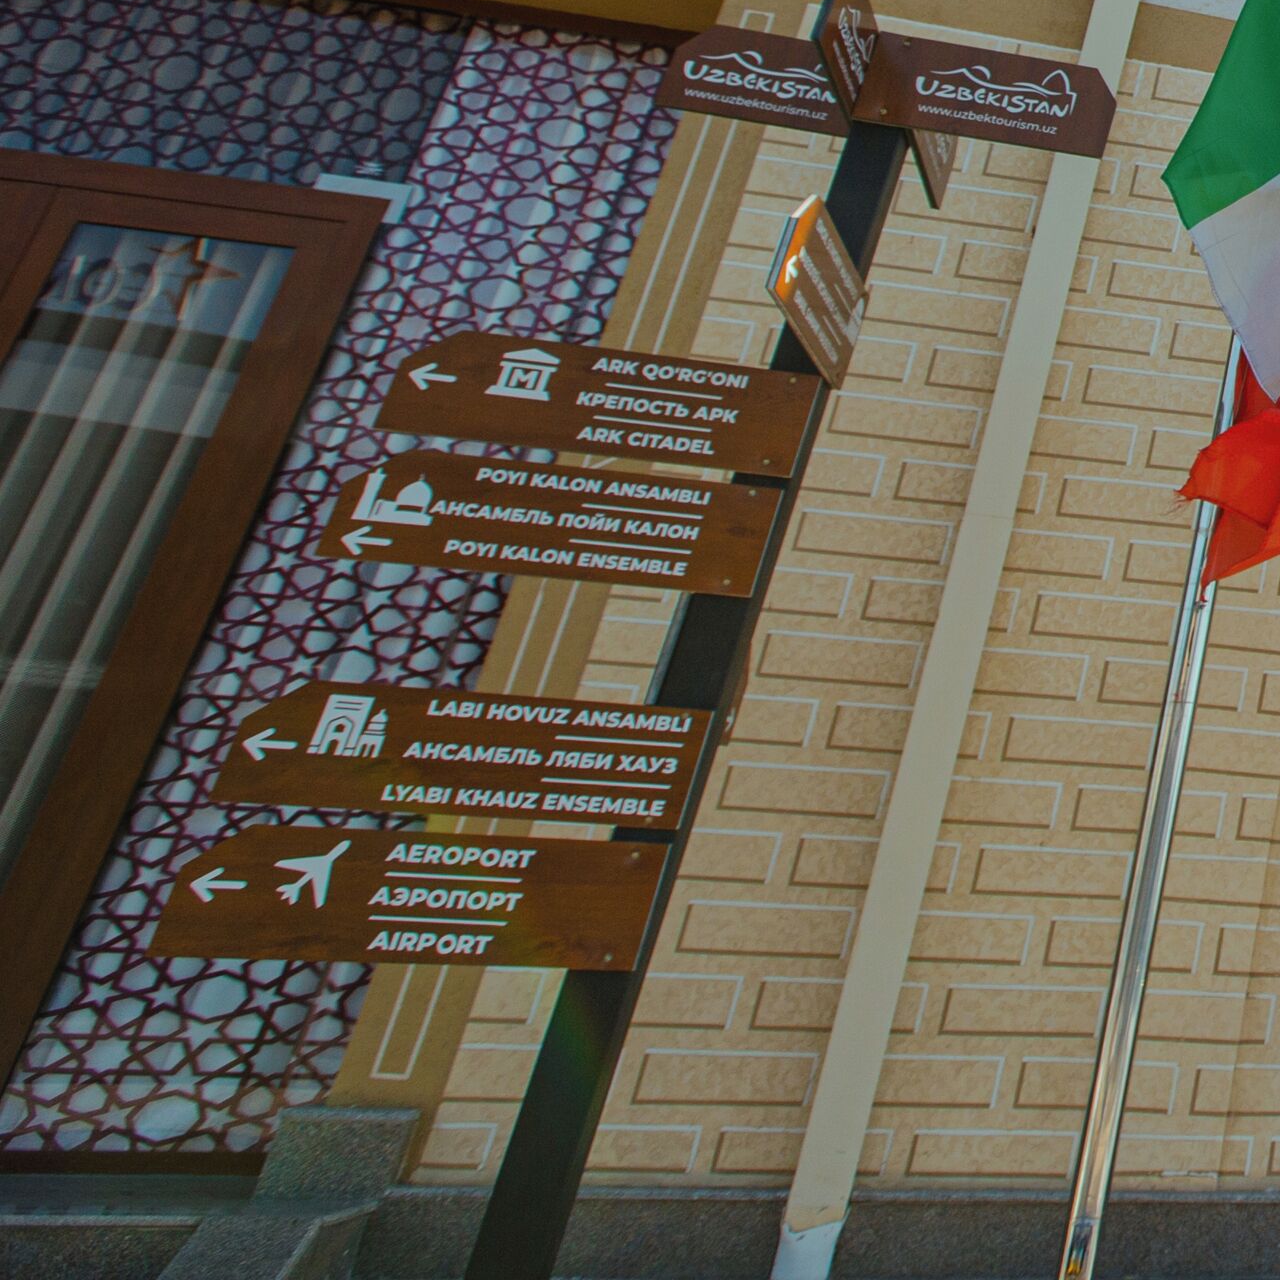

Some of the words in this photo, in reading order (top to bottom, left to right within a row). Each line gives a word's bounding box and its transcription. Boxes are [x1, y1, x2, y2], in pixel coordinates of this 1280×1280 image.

[684, 87, 829, 120] www.uzbektourism.uz
[915, 76, 1069, 118] UZBEKISTAN
[917, 103, 1058, 135] www.uzbektourism.uz
[592, 357, 640, 376] ARK
[641, 363, 750, 389] QO'RG'ONI
[576, 391, 690, 418] КРЕПОСТЬ
[692, 405, 740, 424] АРК
[576, 426, 625, 445] ARK
[627, 431, 716, 455] CITADEL
[475, 467, 527, 486] POYI
[529, 472, 603, 493] KALON
[604, 481, 712, 506] ANSAMBLI
[429, 499, 555, 526] АНСАМБЛЬ
[557, 512, 620, 532] ПОЙИ
[623, 520, 700, 541] КАЛОН
[443, 538, 498, 558] POYI
[499, 544, 574, 565] KALON
[576, 552, 688, 577] ENSEMBLE
[426, 699, 484, 719] LABI
[486, 704, 571, 725] HOVUZ
[572, 709, 693, 734] ANSAMBLI
[403, 741, 543, 766] АНСАМБЛЬ
[545, 750, 614, 770] ЛЯБИ
[616, 754, 678, 775] ХАУЗ
[380, 783, 453, 804] LYABI
[455, 787, 541, 810] KHAUZ
[542, 793, 667, 817] ENSEMBLE
[385, 843, 538, 869] AEROPORT
[367, 886, 524, 912] АЭРОПОРТ
[366, 930, 495, 955] AIRPORT
